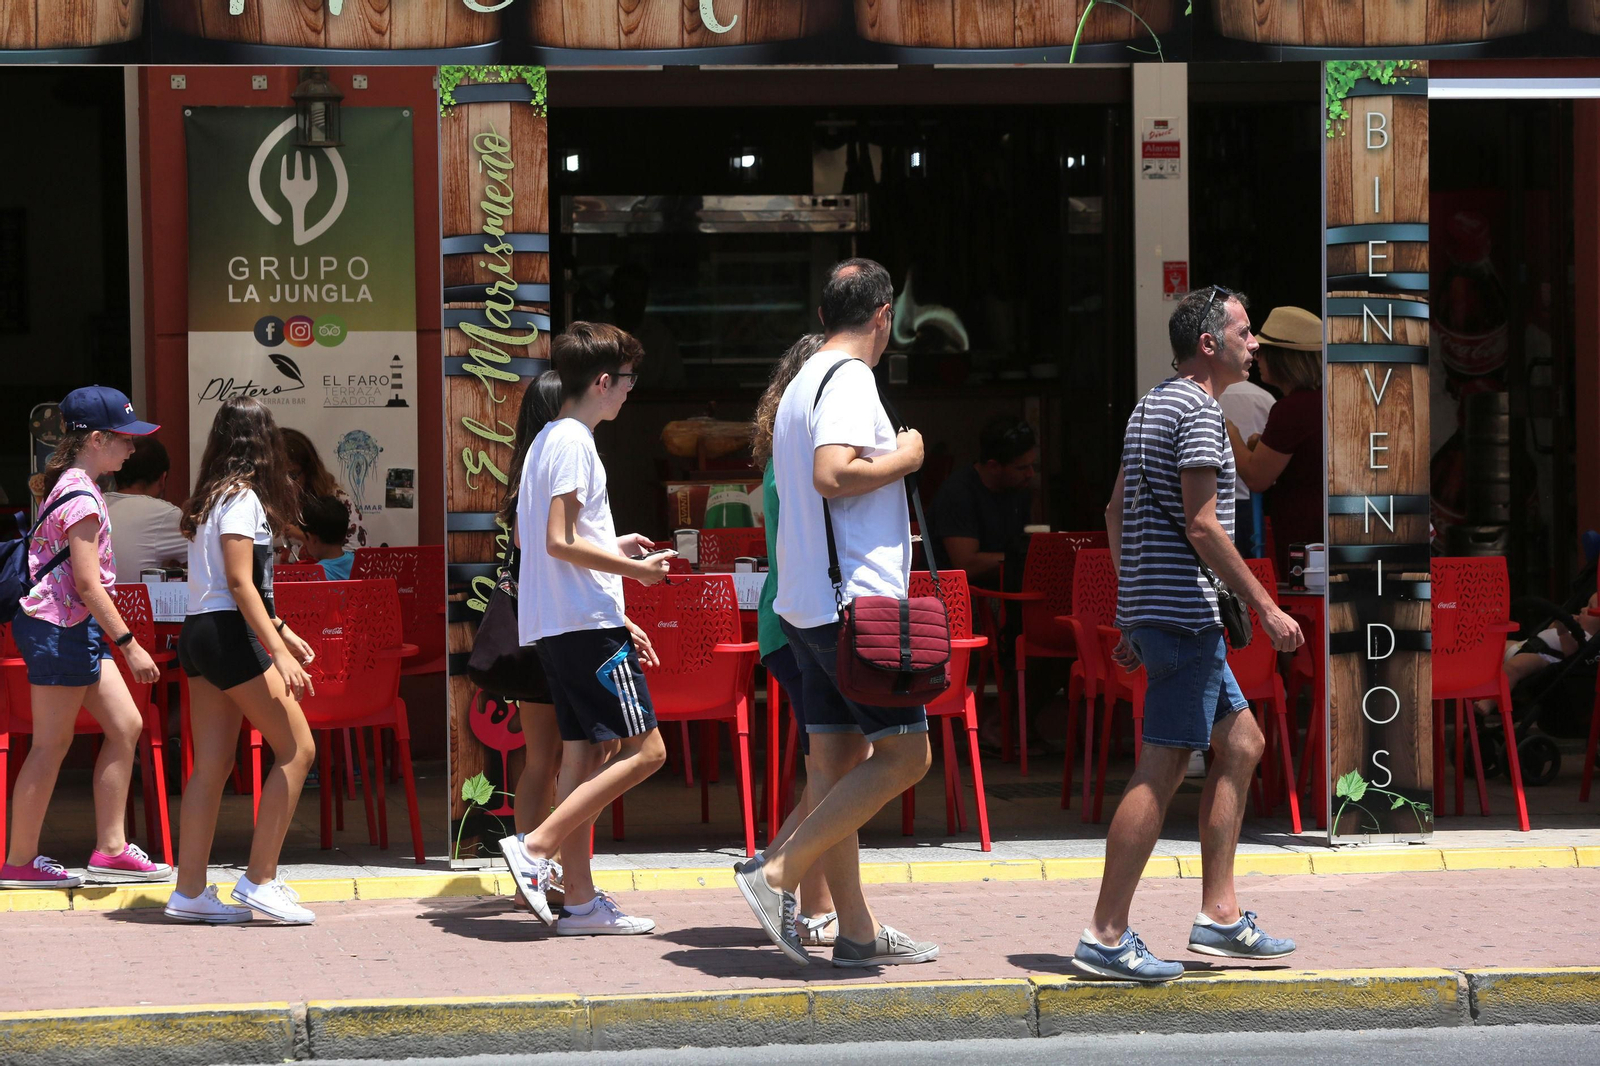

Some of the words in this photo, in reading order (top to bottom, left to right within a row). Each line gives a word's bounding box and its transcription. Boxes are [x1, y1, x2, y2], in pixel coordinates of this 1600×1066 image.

[228, 256, 369, 280] GRUPO
[458, 121, 539, 404] Marismeño
[228, 284, 261, 303] LA
[269, 284, 374, 303] JUNGLA
[323, 375, 341, 387] EL
[348, 375, 390, 387] FARO
[324, 386, 382, 396] TERRAZA
[292, 397, 306, 405] BAR
[323, 396, 376, 406] ASADOR
[461, 417, 516, 490] El
[1363, 111, 1400, 788] BIENVENIDOS
